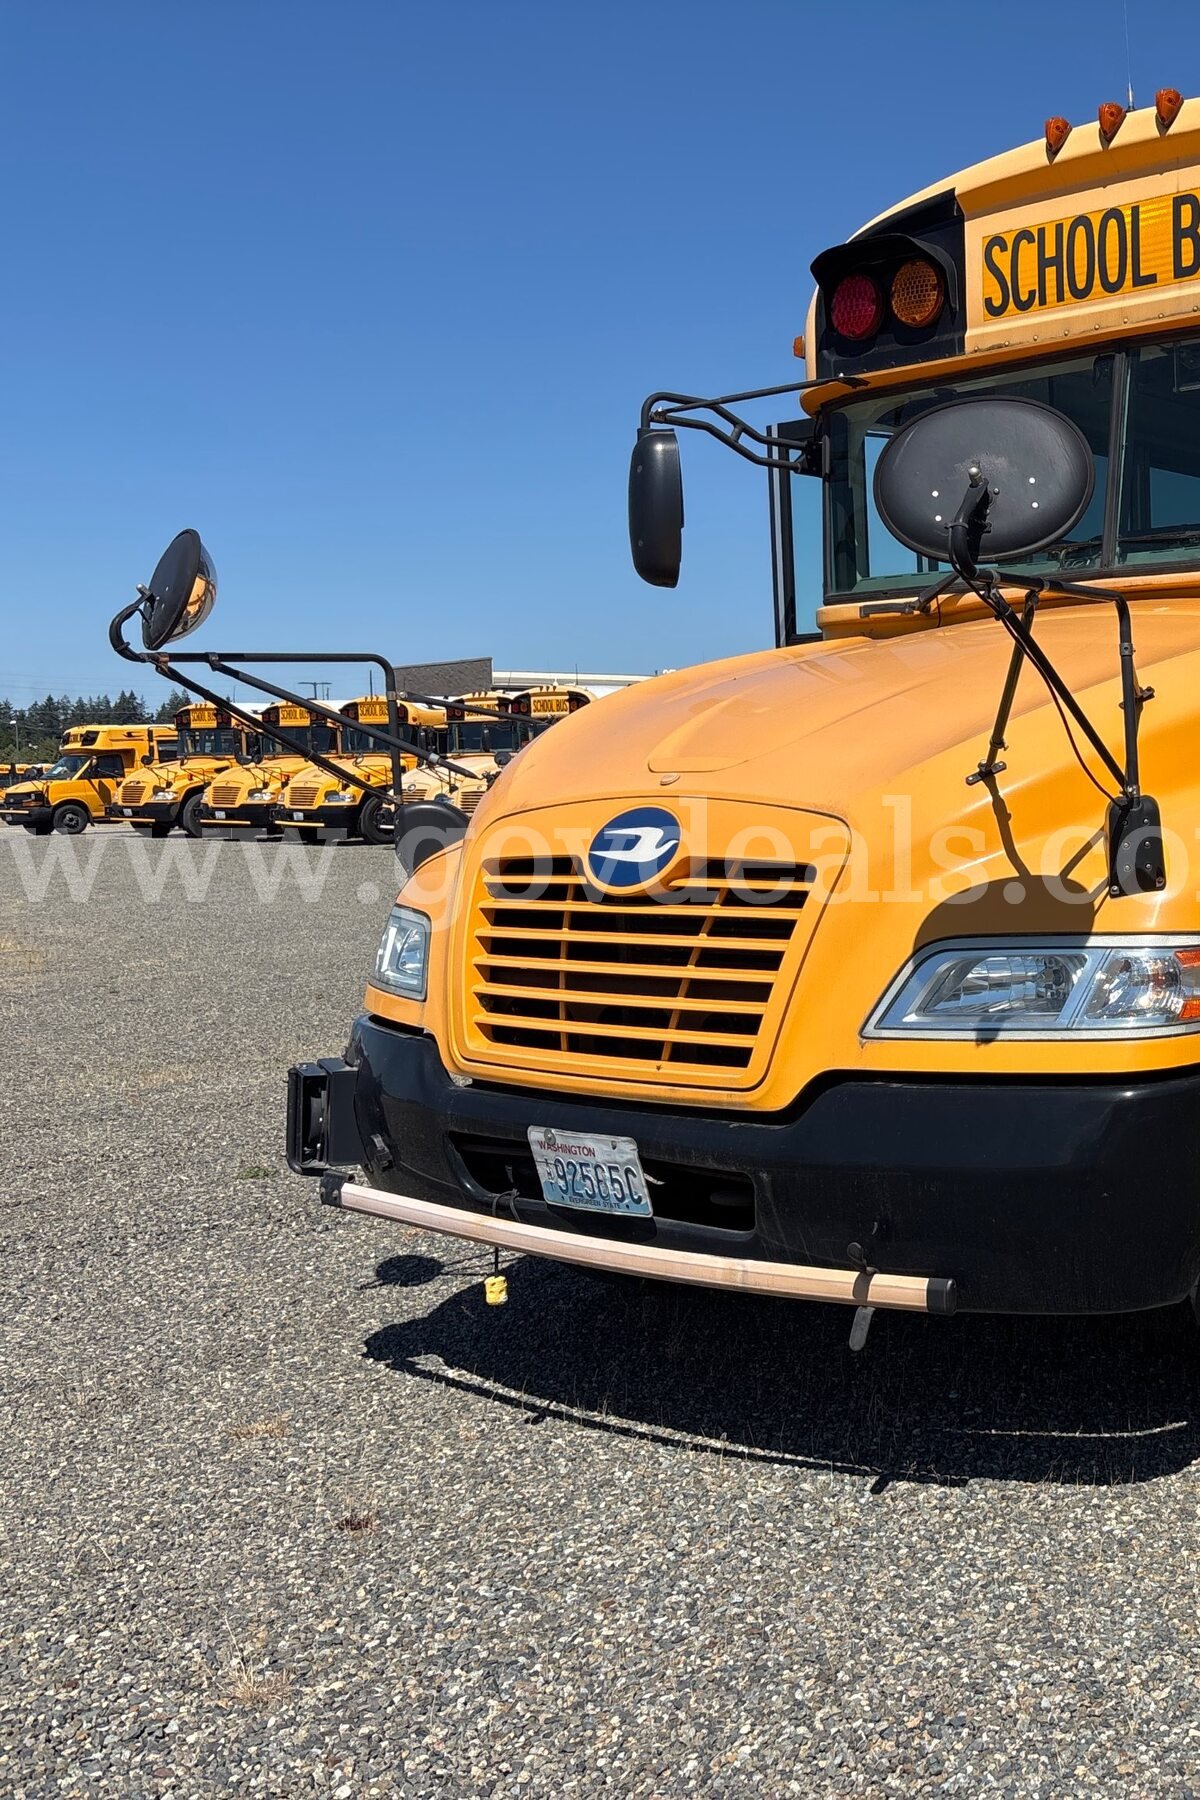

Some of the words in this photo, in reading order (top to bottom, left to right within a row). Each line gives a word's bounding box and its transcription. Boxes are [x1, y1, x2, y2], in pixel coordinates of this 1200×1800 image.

[983, 207, 1158, 318] SCHOOL
[360, 704, 377, 717] SCHOOL
[378, 704, 389, 717] BUS
[533, 699, 555, 713] SCHOOL
[556, 698, 568, 712] BUS
[191, 711, 207, 722] SCHOOL
[281, 709, 297, 720] SCHOOL
[298, 710, 309, 720] BUS
[537, 1139, 596, 1158] WASHINGTON
[602, 1201, 622, 1210] STATE
